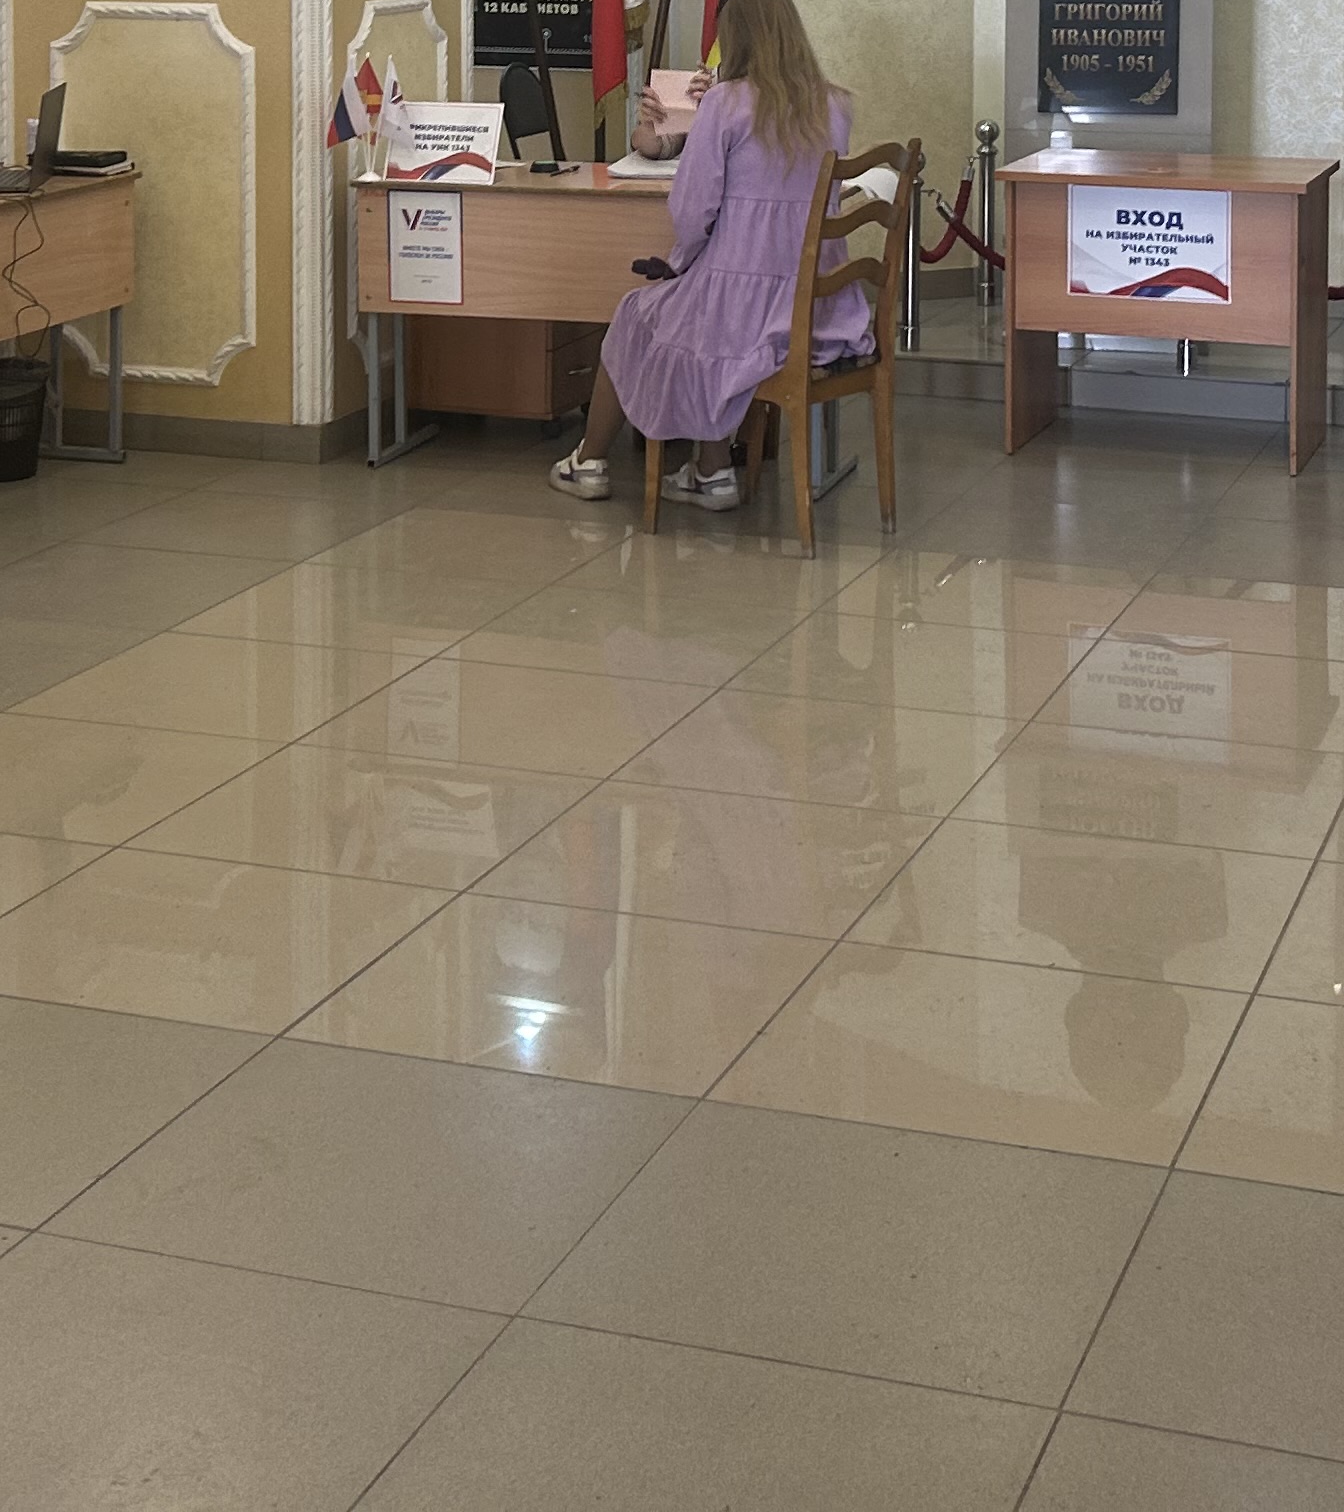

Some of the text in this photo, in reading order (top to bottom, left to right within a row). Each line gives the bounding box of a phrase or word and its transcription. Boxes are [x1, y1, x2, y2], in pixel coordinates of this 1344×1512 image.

[483, 1, 580, 15] 12 КАБНЕТОВ
[1053, 0, 1164, 21] ГРИГОРИЙ
[1050, 28, 1166, 47] ИВАНОВИЧ
[1061, 53, 1101, 72] 1905
[1117, 54, 1155, 73] 1951
[409, 123, 490, 133] РИКРЕПИВШИЕСЯ
[414, 133, 475, 142] ИЗБИРАТЕЛИ
[415, 143, 429, 151] НА
[1115, 209, 1184, 231] ВХОД
[1085, 229, 1215, 245] НА ИЗБИРАТЕЛЬНЫЙ
[1121, 243, 1178, 255] УЧАСТОК
[1144, 257, 1170, 267] 1343
